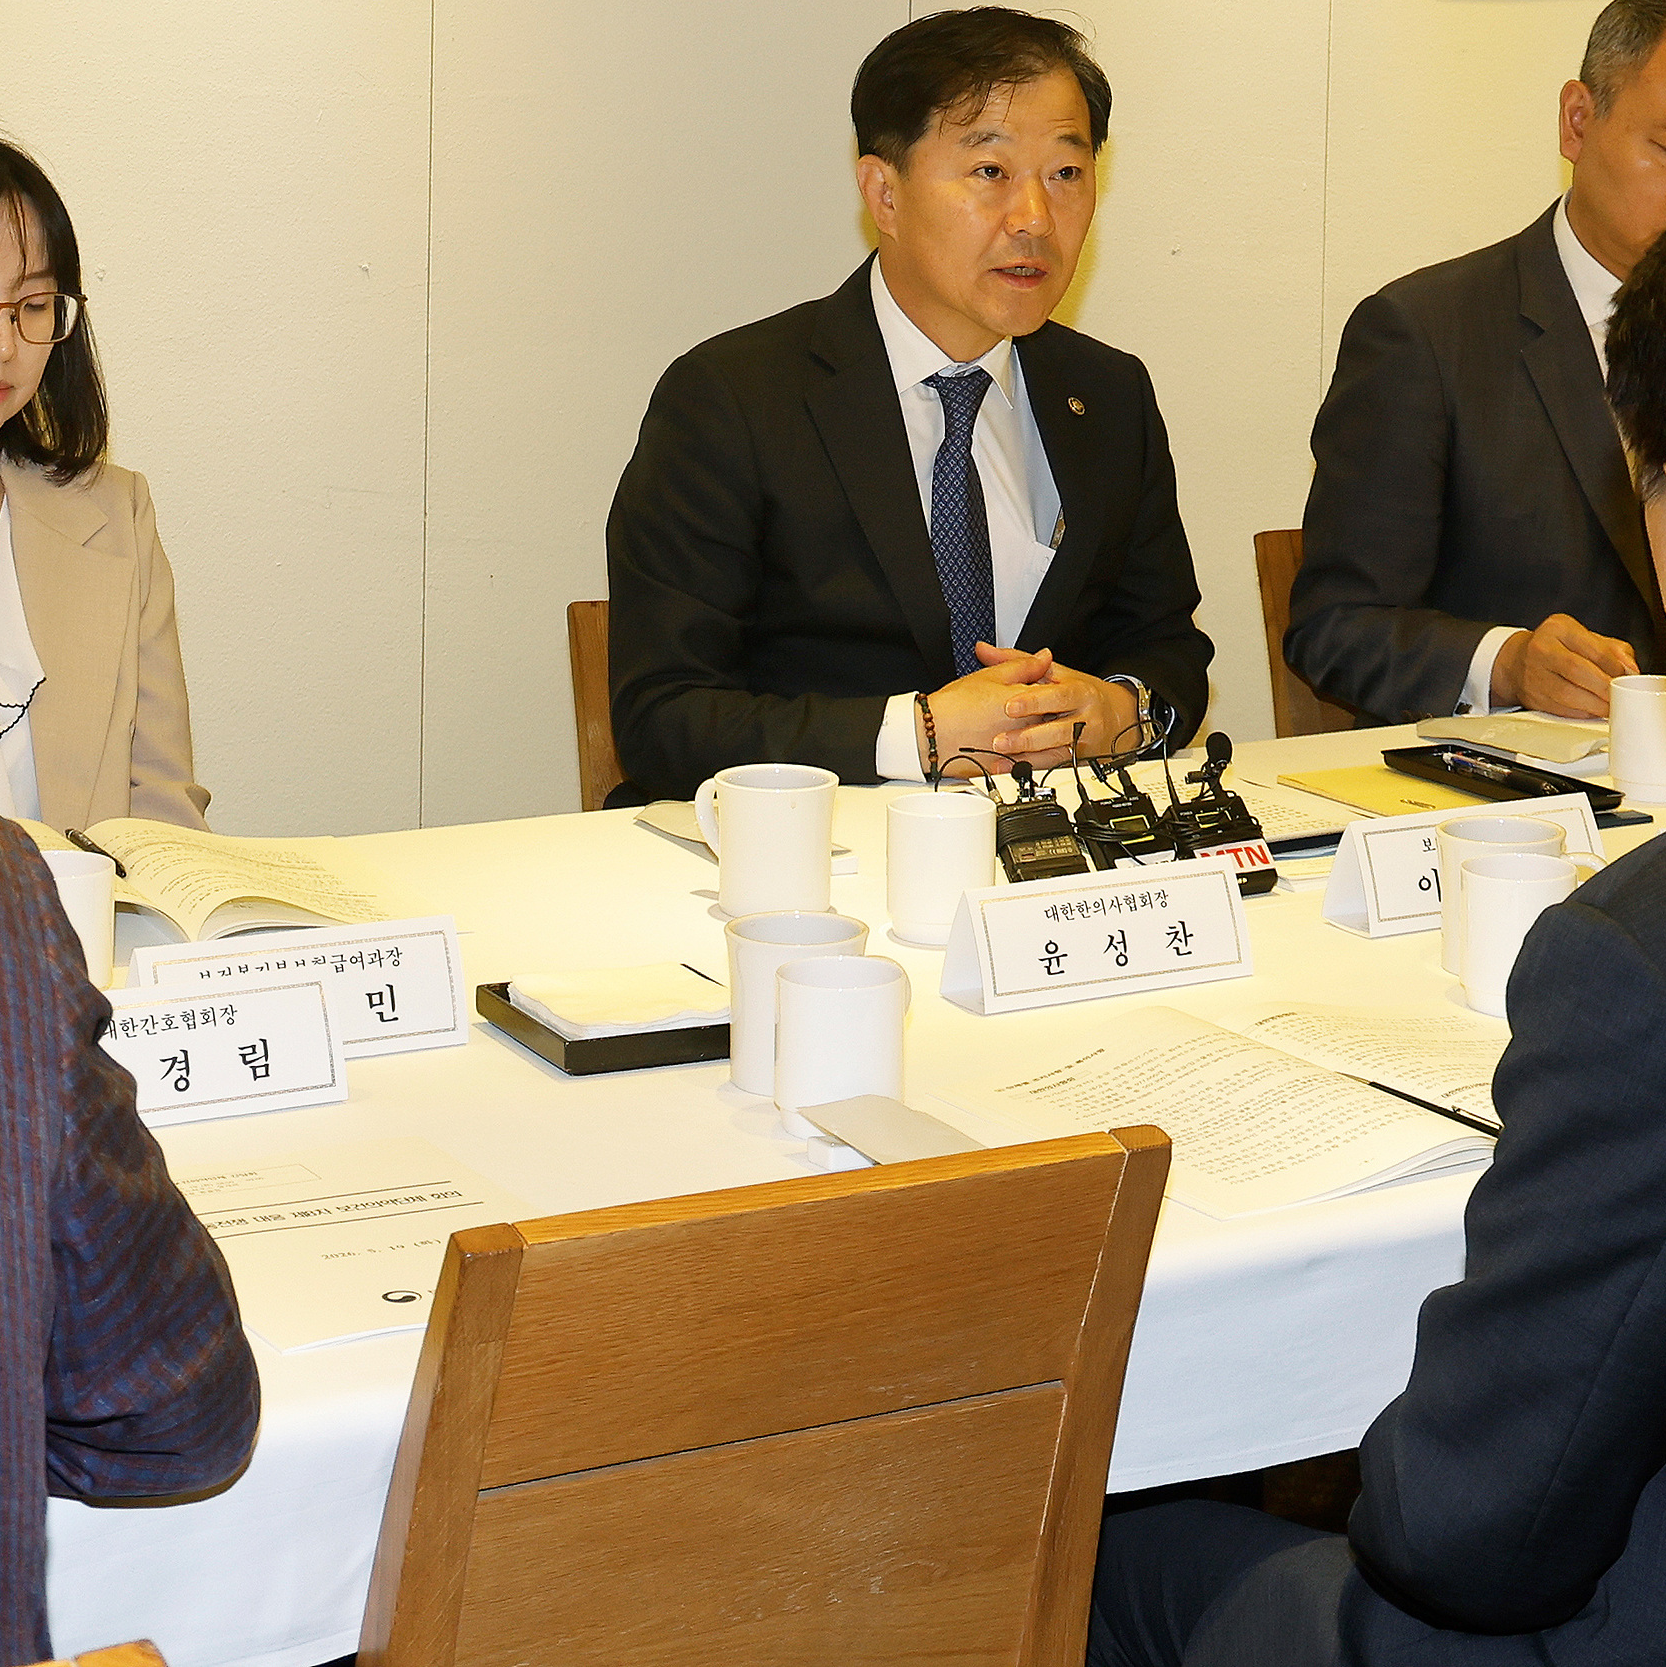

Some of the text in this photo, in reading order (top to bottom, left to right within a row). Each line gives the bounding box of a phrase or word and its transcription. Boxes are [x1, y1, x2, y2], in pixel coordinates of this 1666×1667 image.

[1043, 889, 1170, 923] 대한한의사협회장
[1037, 920, 1195, 976] 윤 성 찬
[365, 983, 400, 1023] 민
[159, 1037, 272, 1093] 경 림
